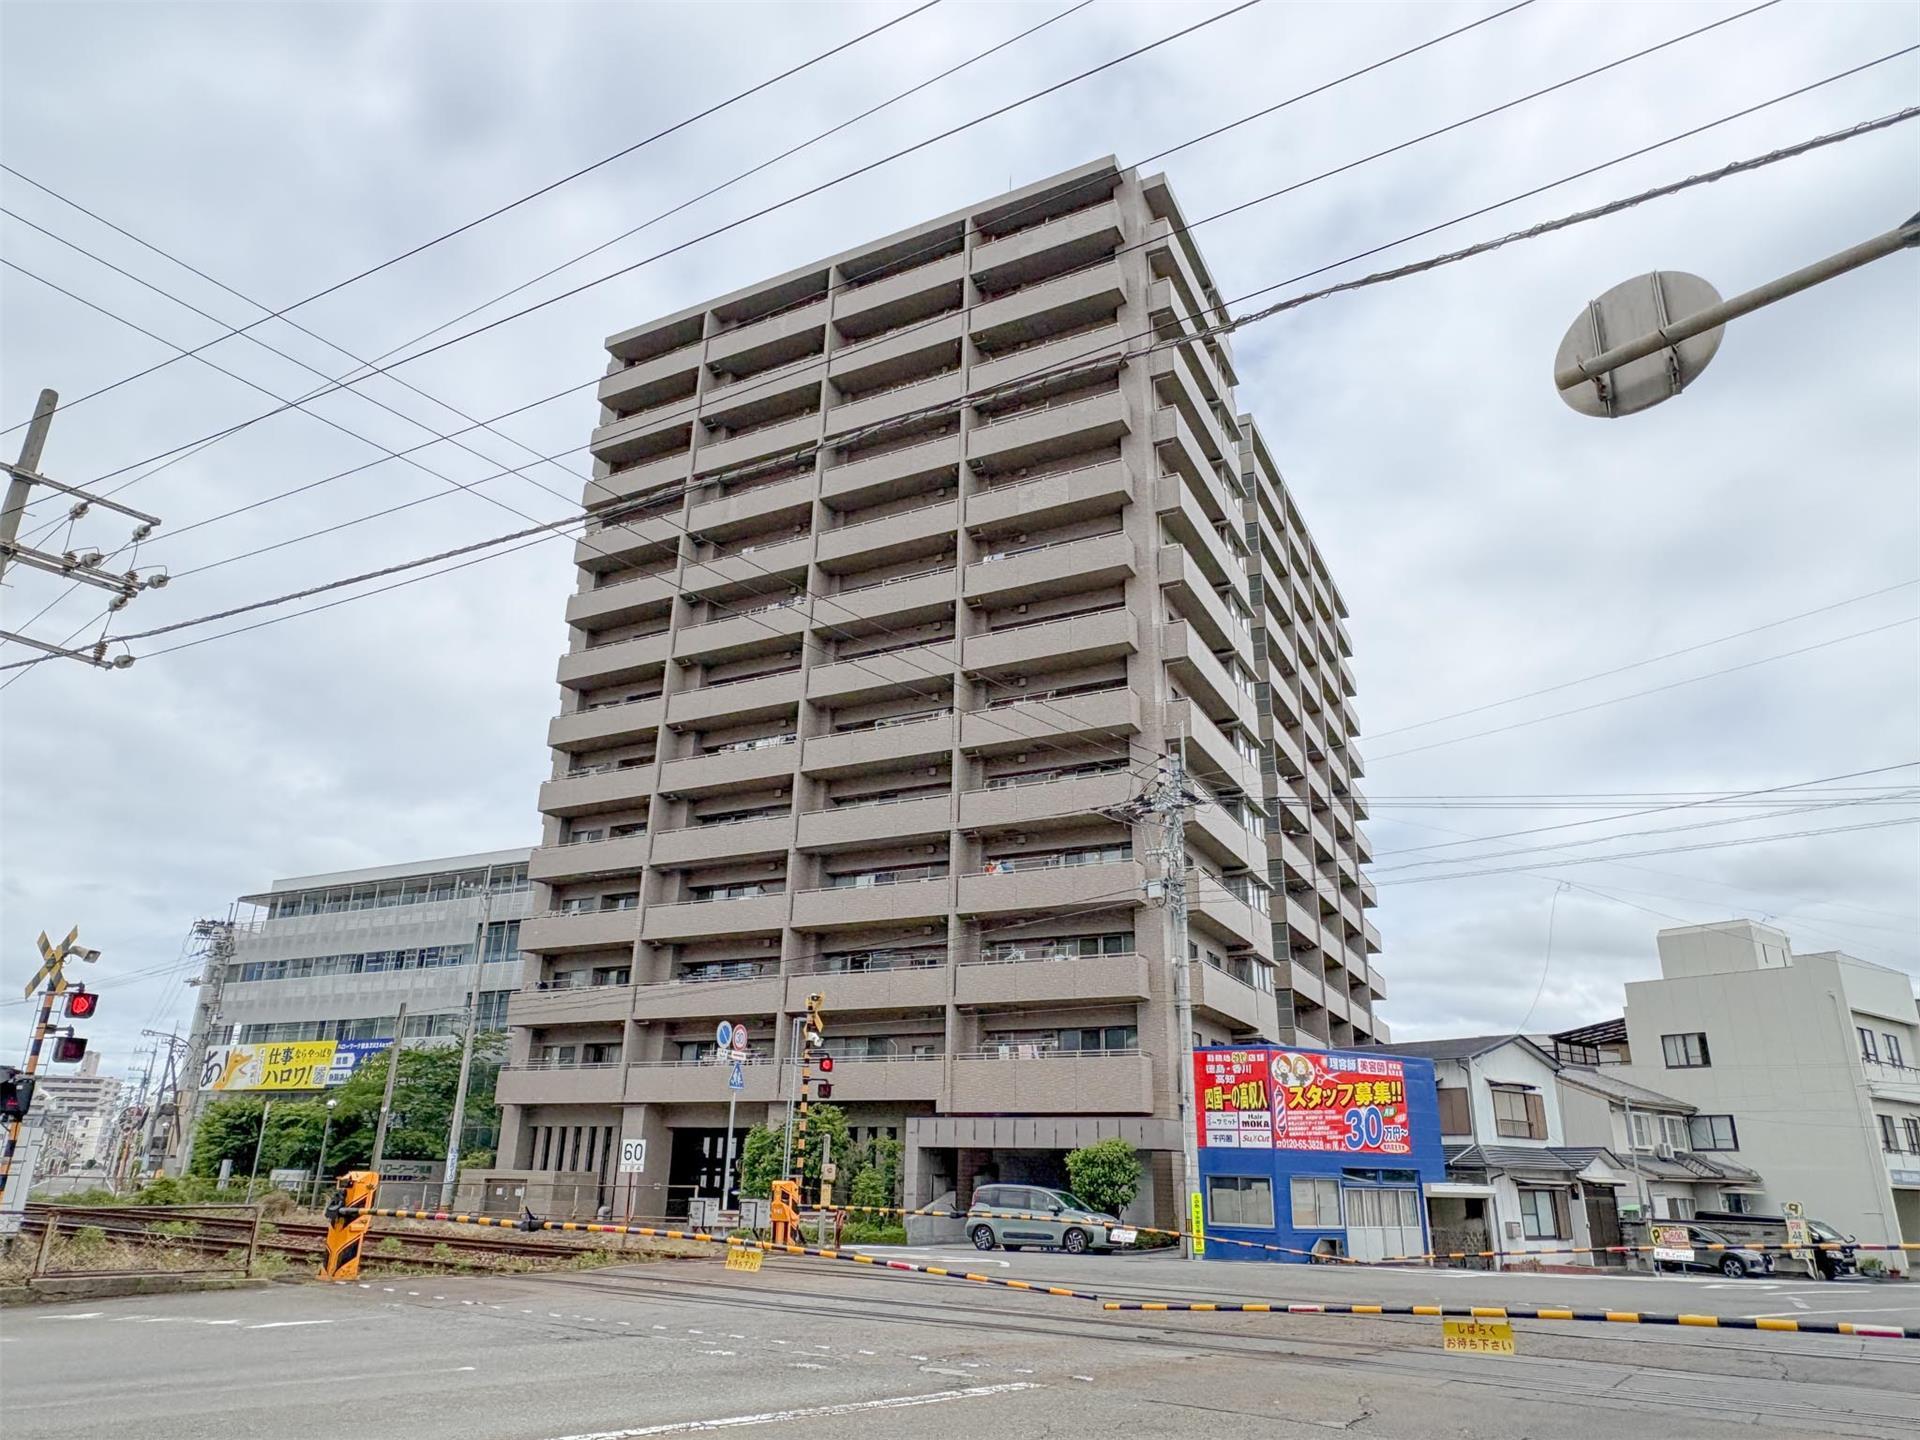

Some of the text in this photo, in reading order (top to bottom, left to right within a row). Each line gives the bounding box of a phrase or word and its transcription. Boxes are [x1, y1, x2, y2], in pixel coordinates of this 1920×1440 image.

[201, 1050, 230, 1087] あ!
[261, 1065, 313, 1087] ハロワ!
[1204, 1080, 1268, 1110] 四国一の高収入
[1288, 1081, 1403, 1109] スタッフ募集!!
[1345, 1105, 1383, 1149] 30
[624, 1143, 643, 1161] 60
[1652, 1229, 1660, 1244] P
[1457, 1322, 1496, 1335] しばらく
[1447, 1338, 1513, 1351] お待ち下さい
